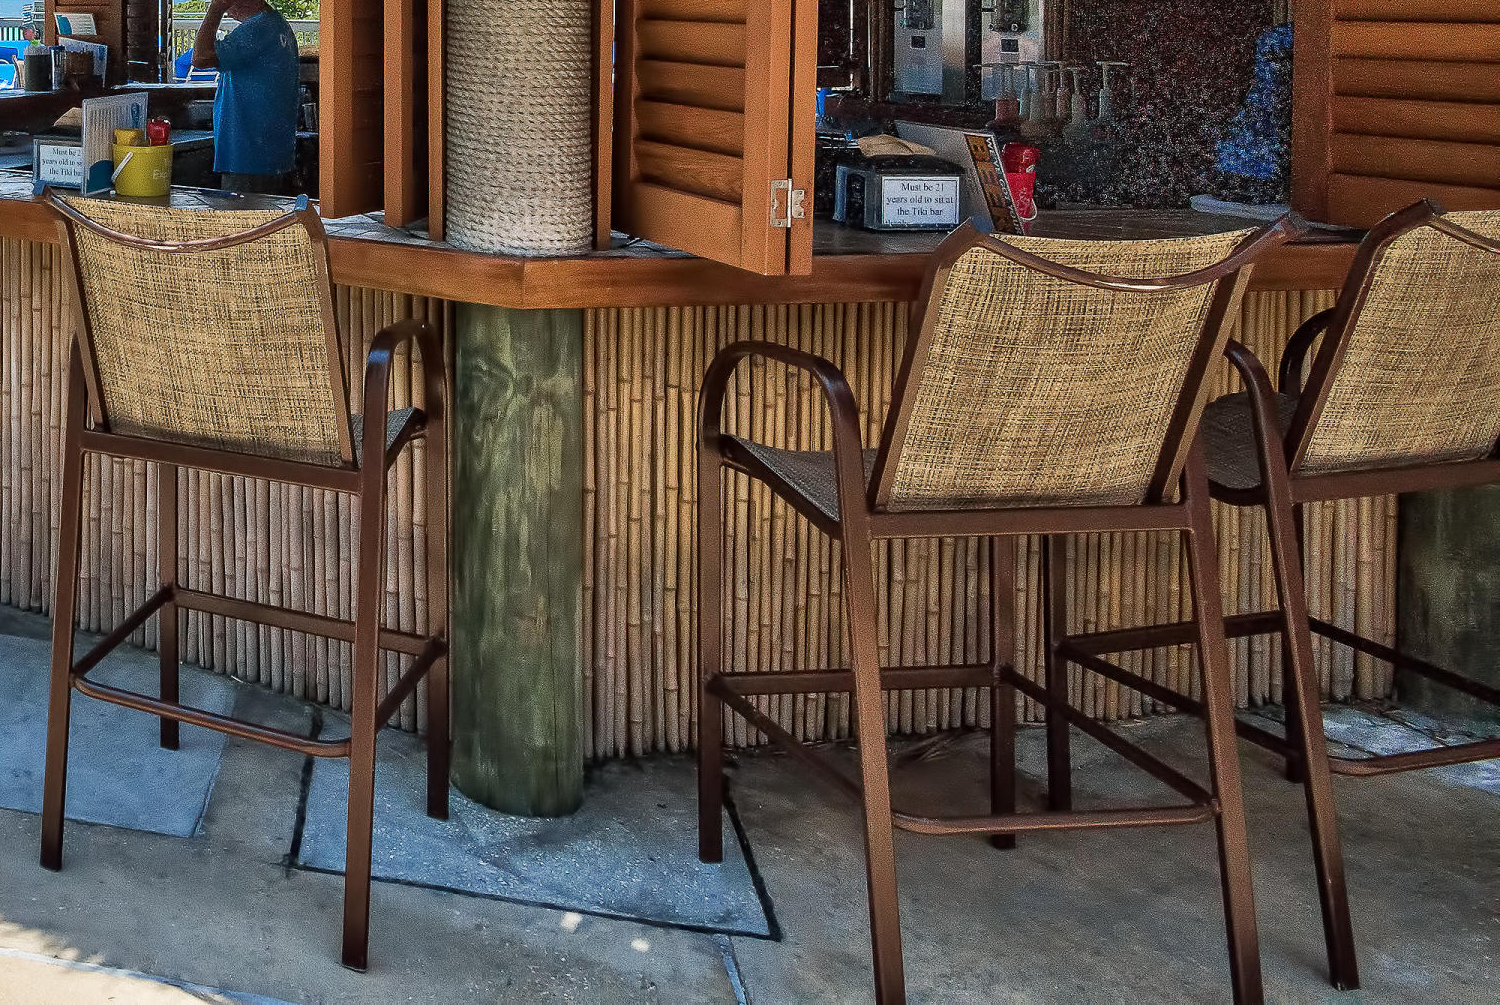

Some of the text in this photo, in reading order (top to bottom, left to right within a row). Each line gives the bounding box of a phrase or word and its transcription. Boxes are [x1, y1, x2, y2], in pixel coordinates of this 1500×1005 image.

[68, 148, 77, 156] be
[58, 158, 69, 166] old
[901, 183, 944, 191] Must be 21
[886, 197, 908, 205] years
[897, 207, 943, 215] the Tiki bar
